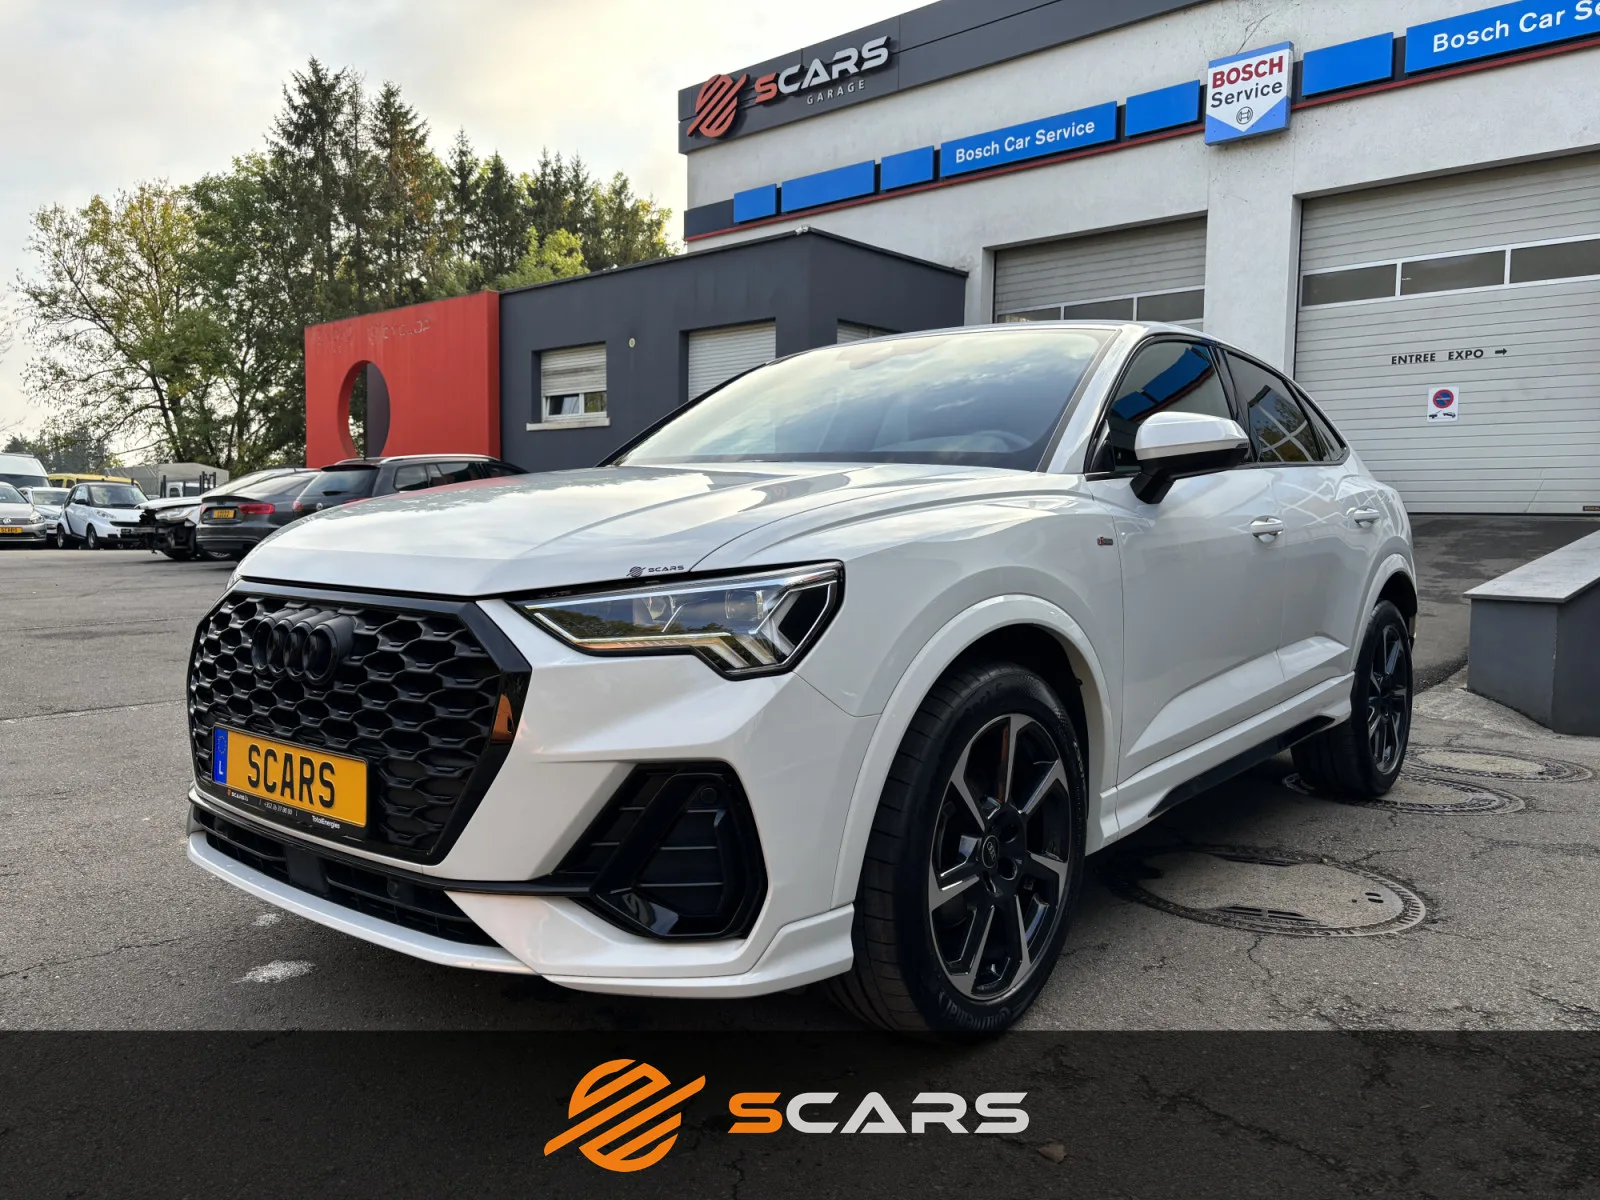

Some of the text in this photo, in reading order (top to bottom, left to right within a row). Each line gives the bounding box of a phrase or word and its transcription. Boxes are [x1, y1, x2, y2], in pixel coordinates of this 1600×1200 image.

[1433, 20, 1509, 53] Bosch
[1519, 11, 1566, 33] Car
[754, 35, 889, 105] SCARS
[1212, 55, 1283, 89] BOSCH
[806, 79, 866, 105] GARAGE
[1210, 81, 1283, 108] Service
[955, 121, 1095, 164] Bosch Car Service
[1391, 348, 1484, 365] ENTREE EXPO
[648, 564, 685, 573] SCARS
[247, 743, 336, 809] SCARS
